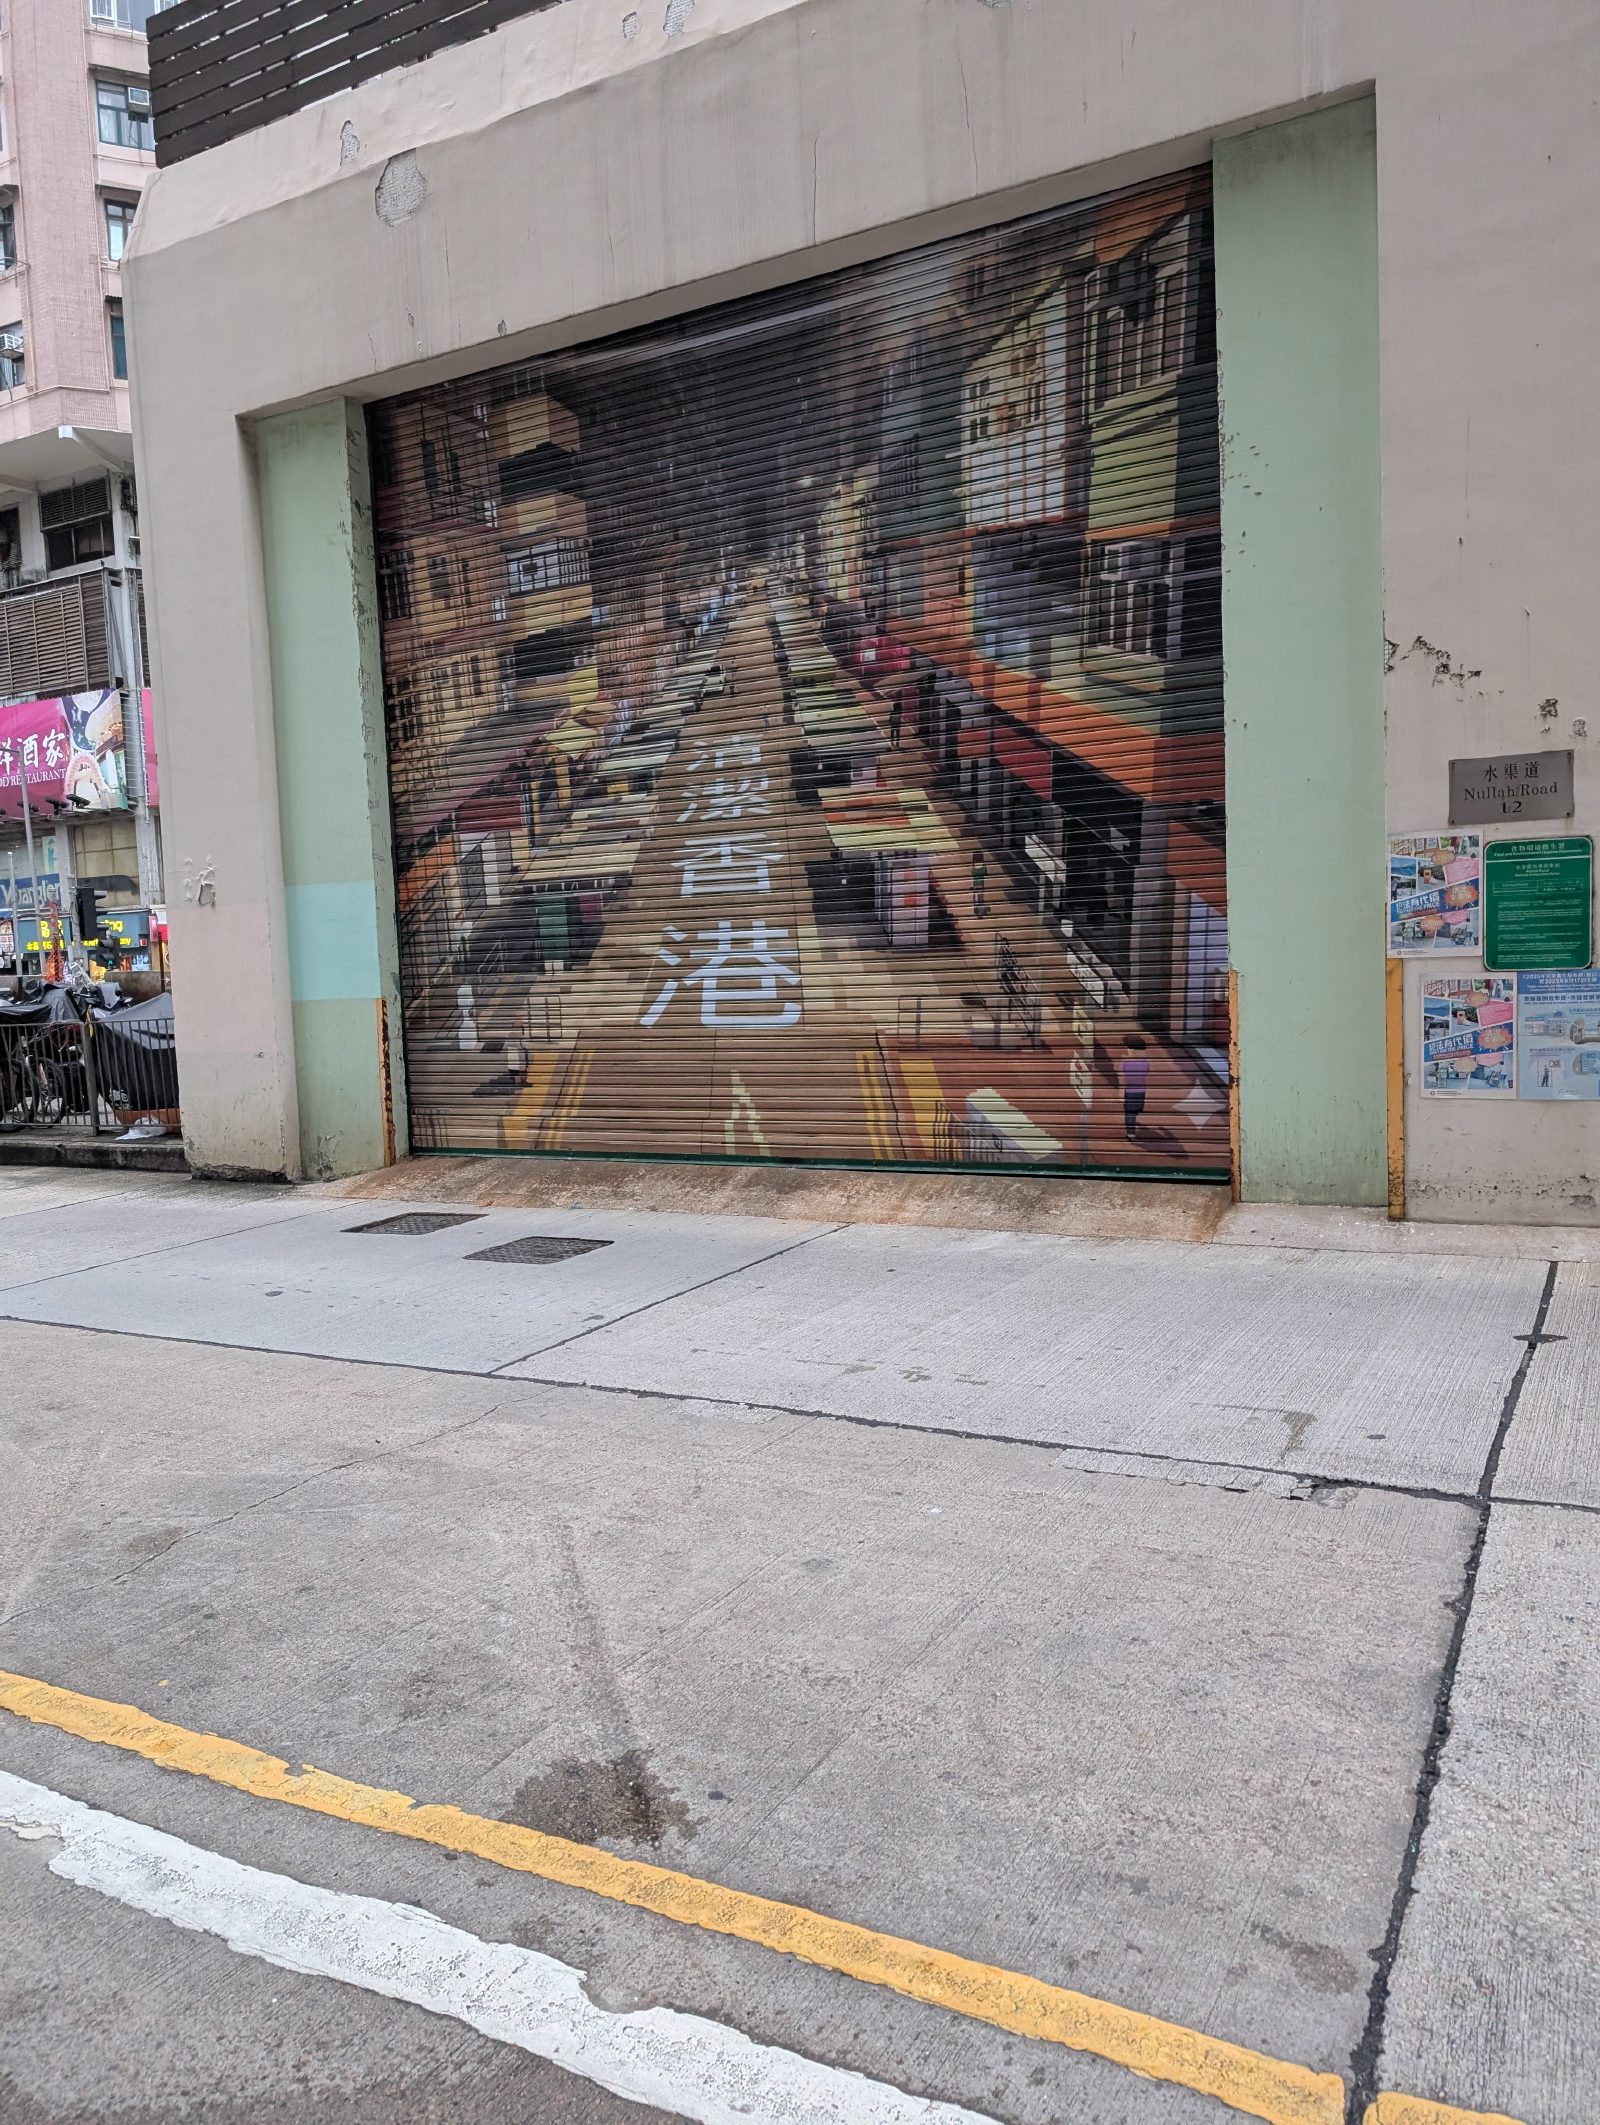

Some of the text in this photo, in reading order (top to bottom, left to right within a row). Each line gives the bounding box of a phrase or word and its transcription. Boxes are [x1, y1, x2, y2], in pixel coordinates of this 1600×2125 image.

[10, 768, 66, 786] RETAURANT
[1484, 761, 1540, 782] 水渠道
[1464, 782, 1558, 801] Nullah Road
